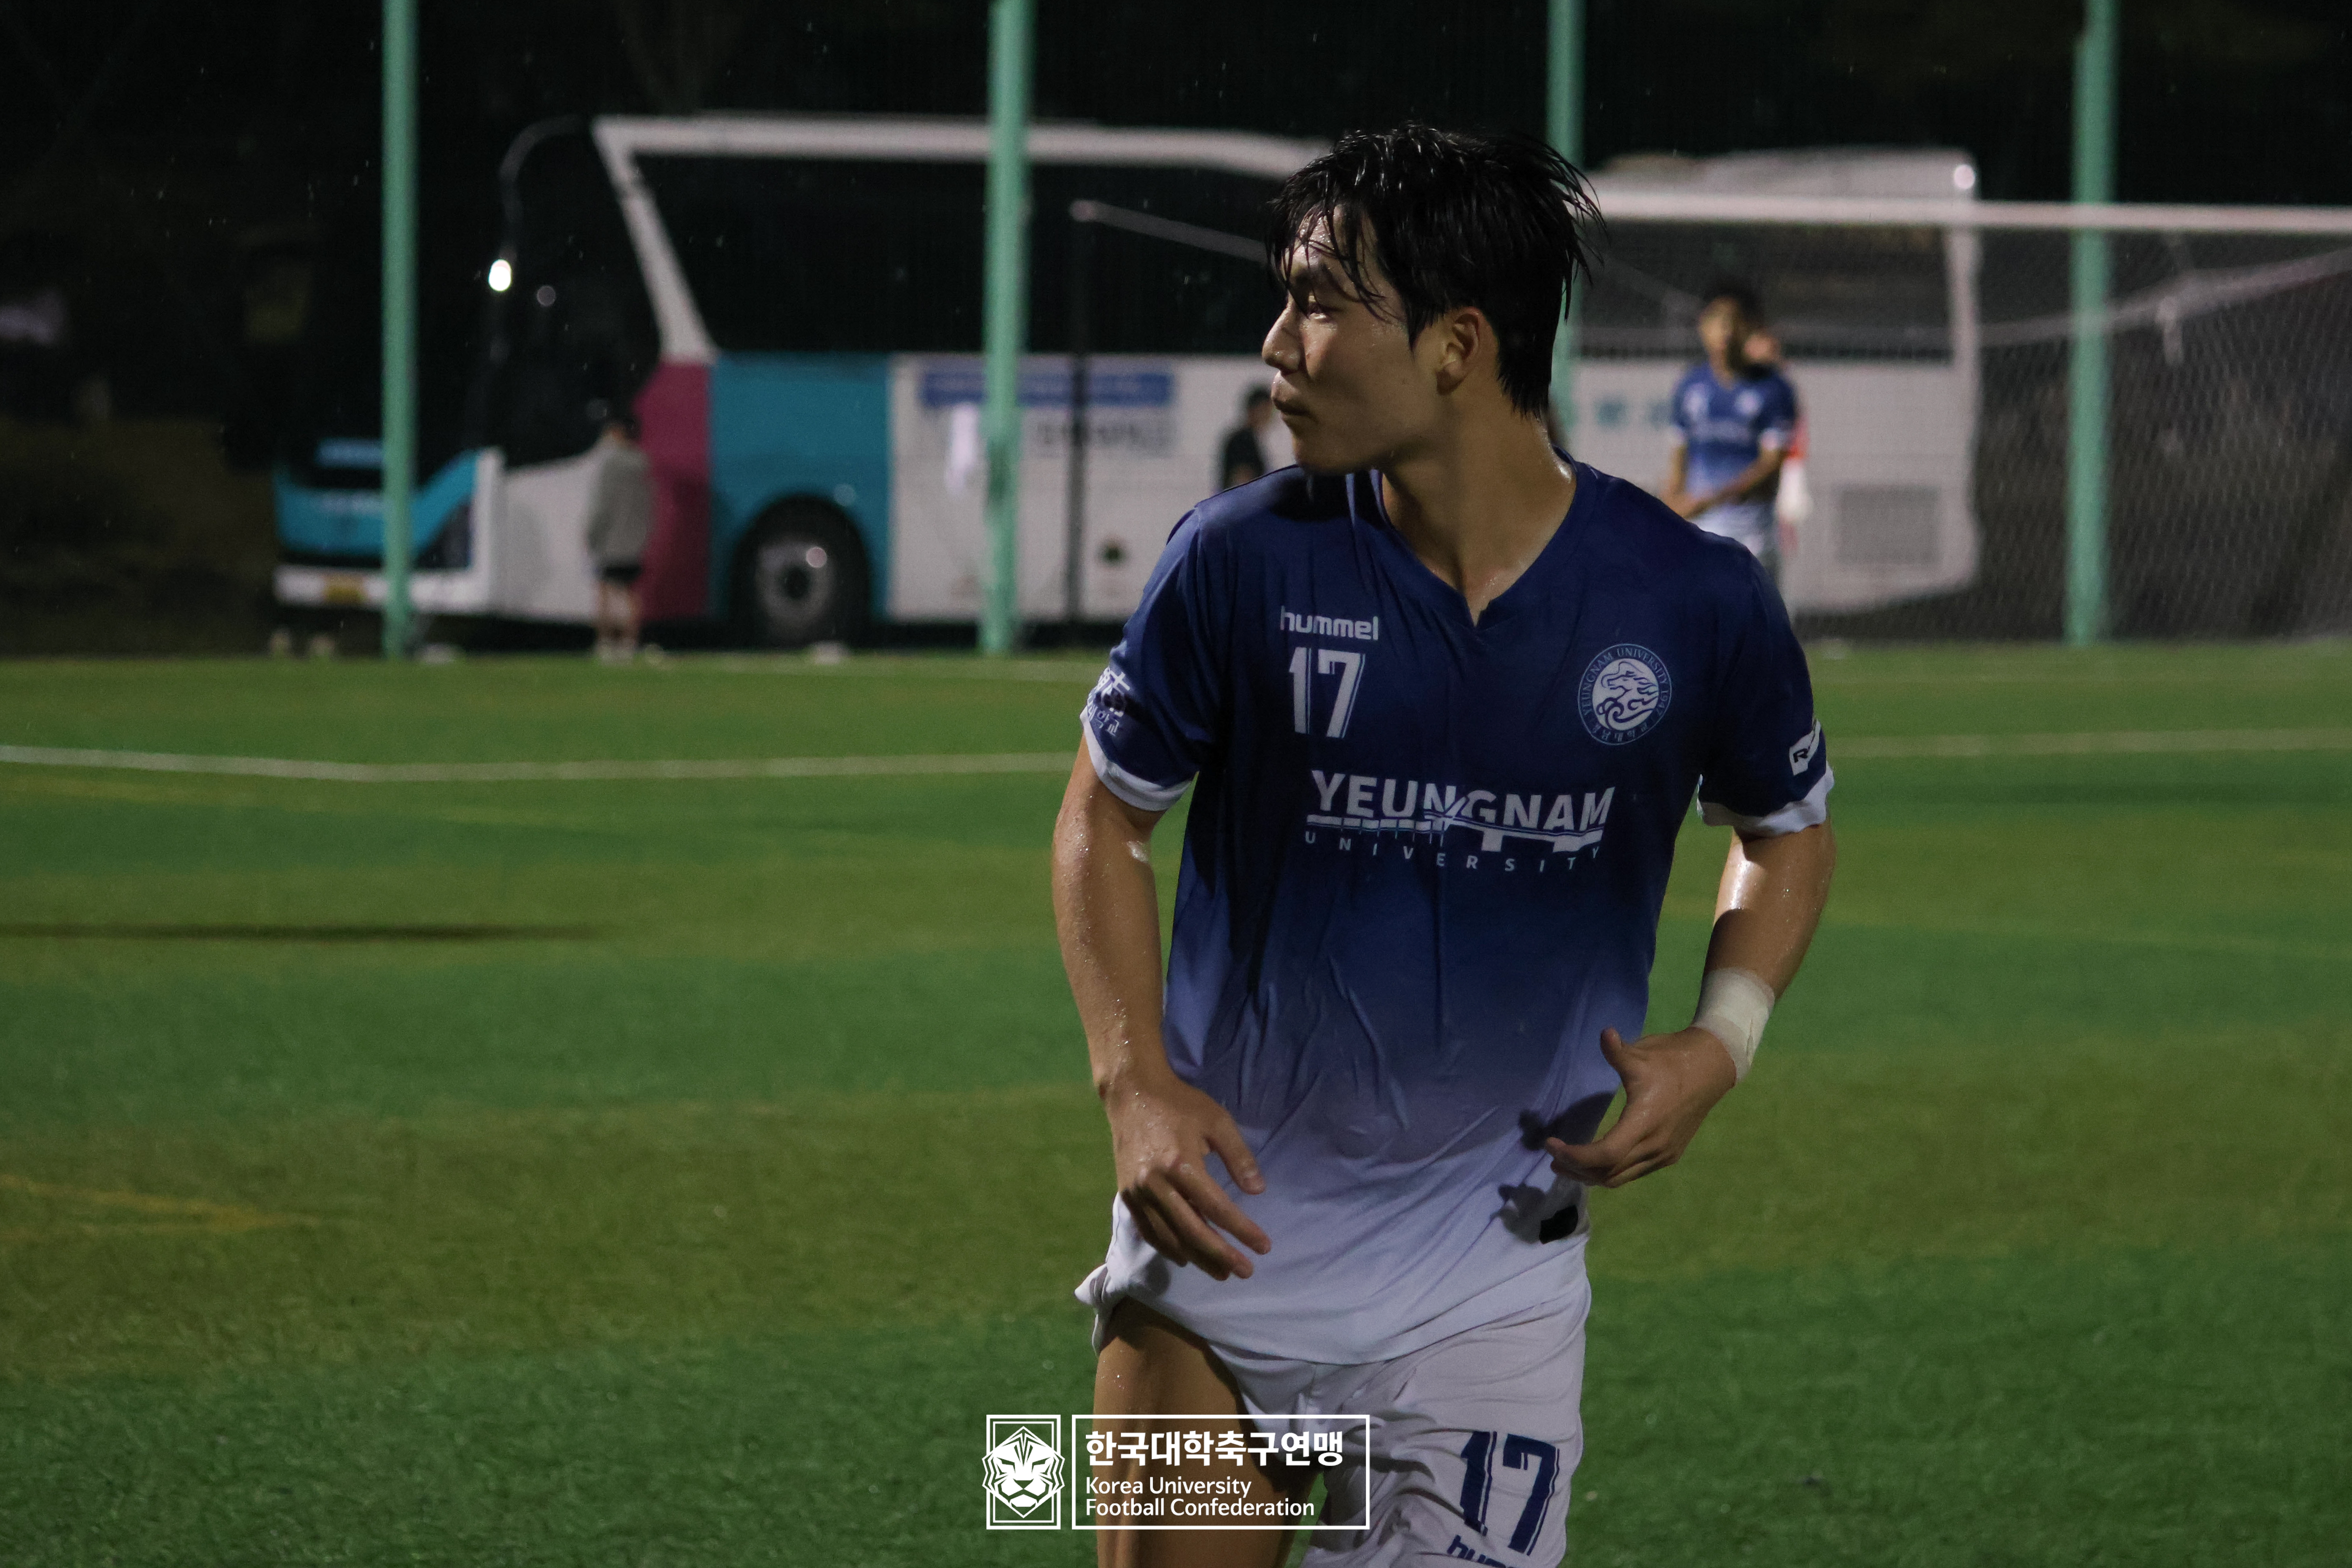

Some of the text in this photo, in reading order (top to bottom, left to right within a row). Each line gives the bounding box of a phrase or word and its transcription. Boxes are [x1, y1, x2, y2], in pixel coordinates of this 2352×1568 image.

[1280, 606, 1379, 641] hummel
[1289, 647, 1365, 738] 17
[1581, 652, 1614, 716] YEUNGNAM
[1617, 648, 1669, 684] UNIVERSITY
[1312, 770, 1615, 832] YEUNGNAM
[1305, 831, 1600, 873] UNIVERSITY
[1460, 1431, 1560, 1555] 17
